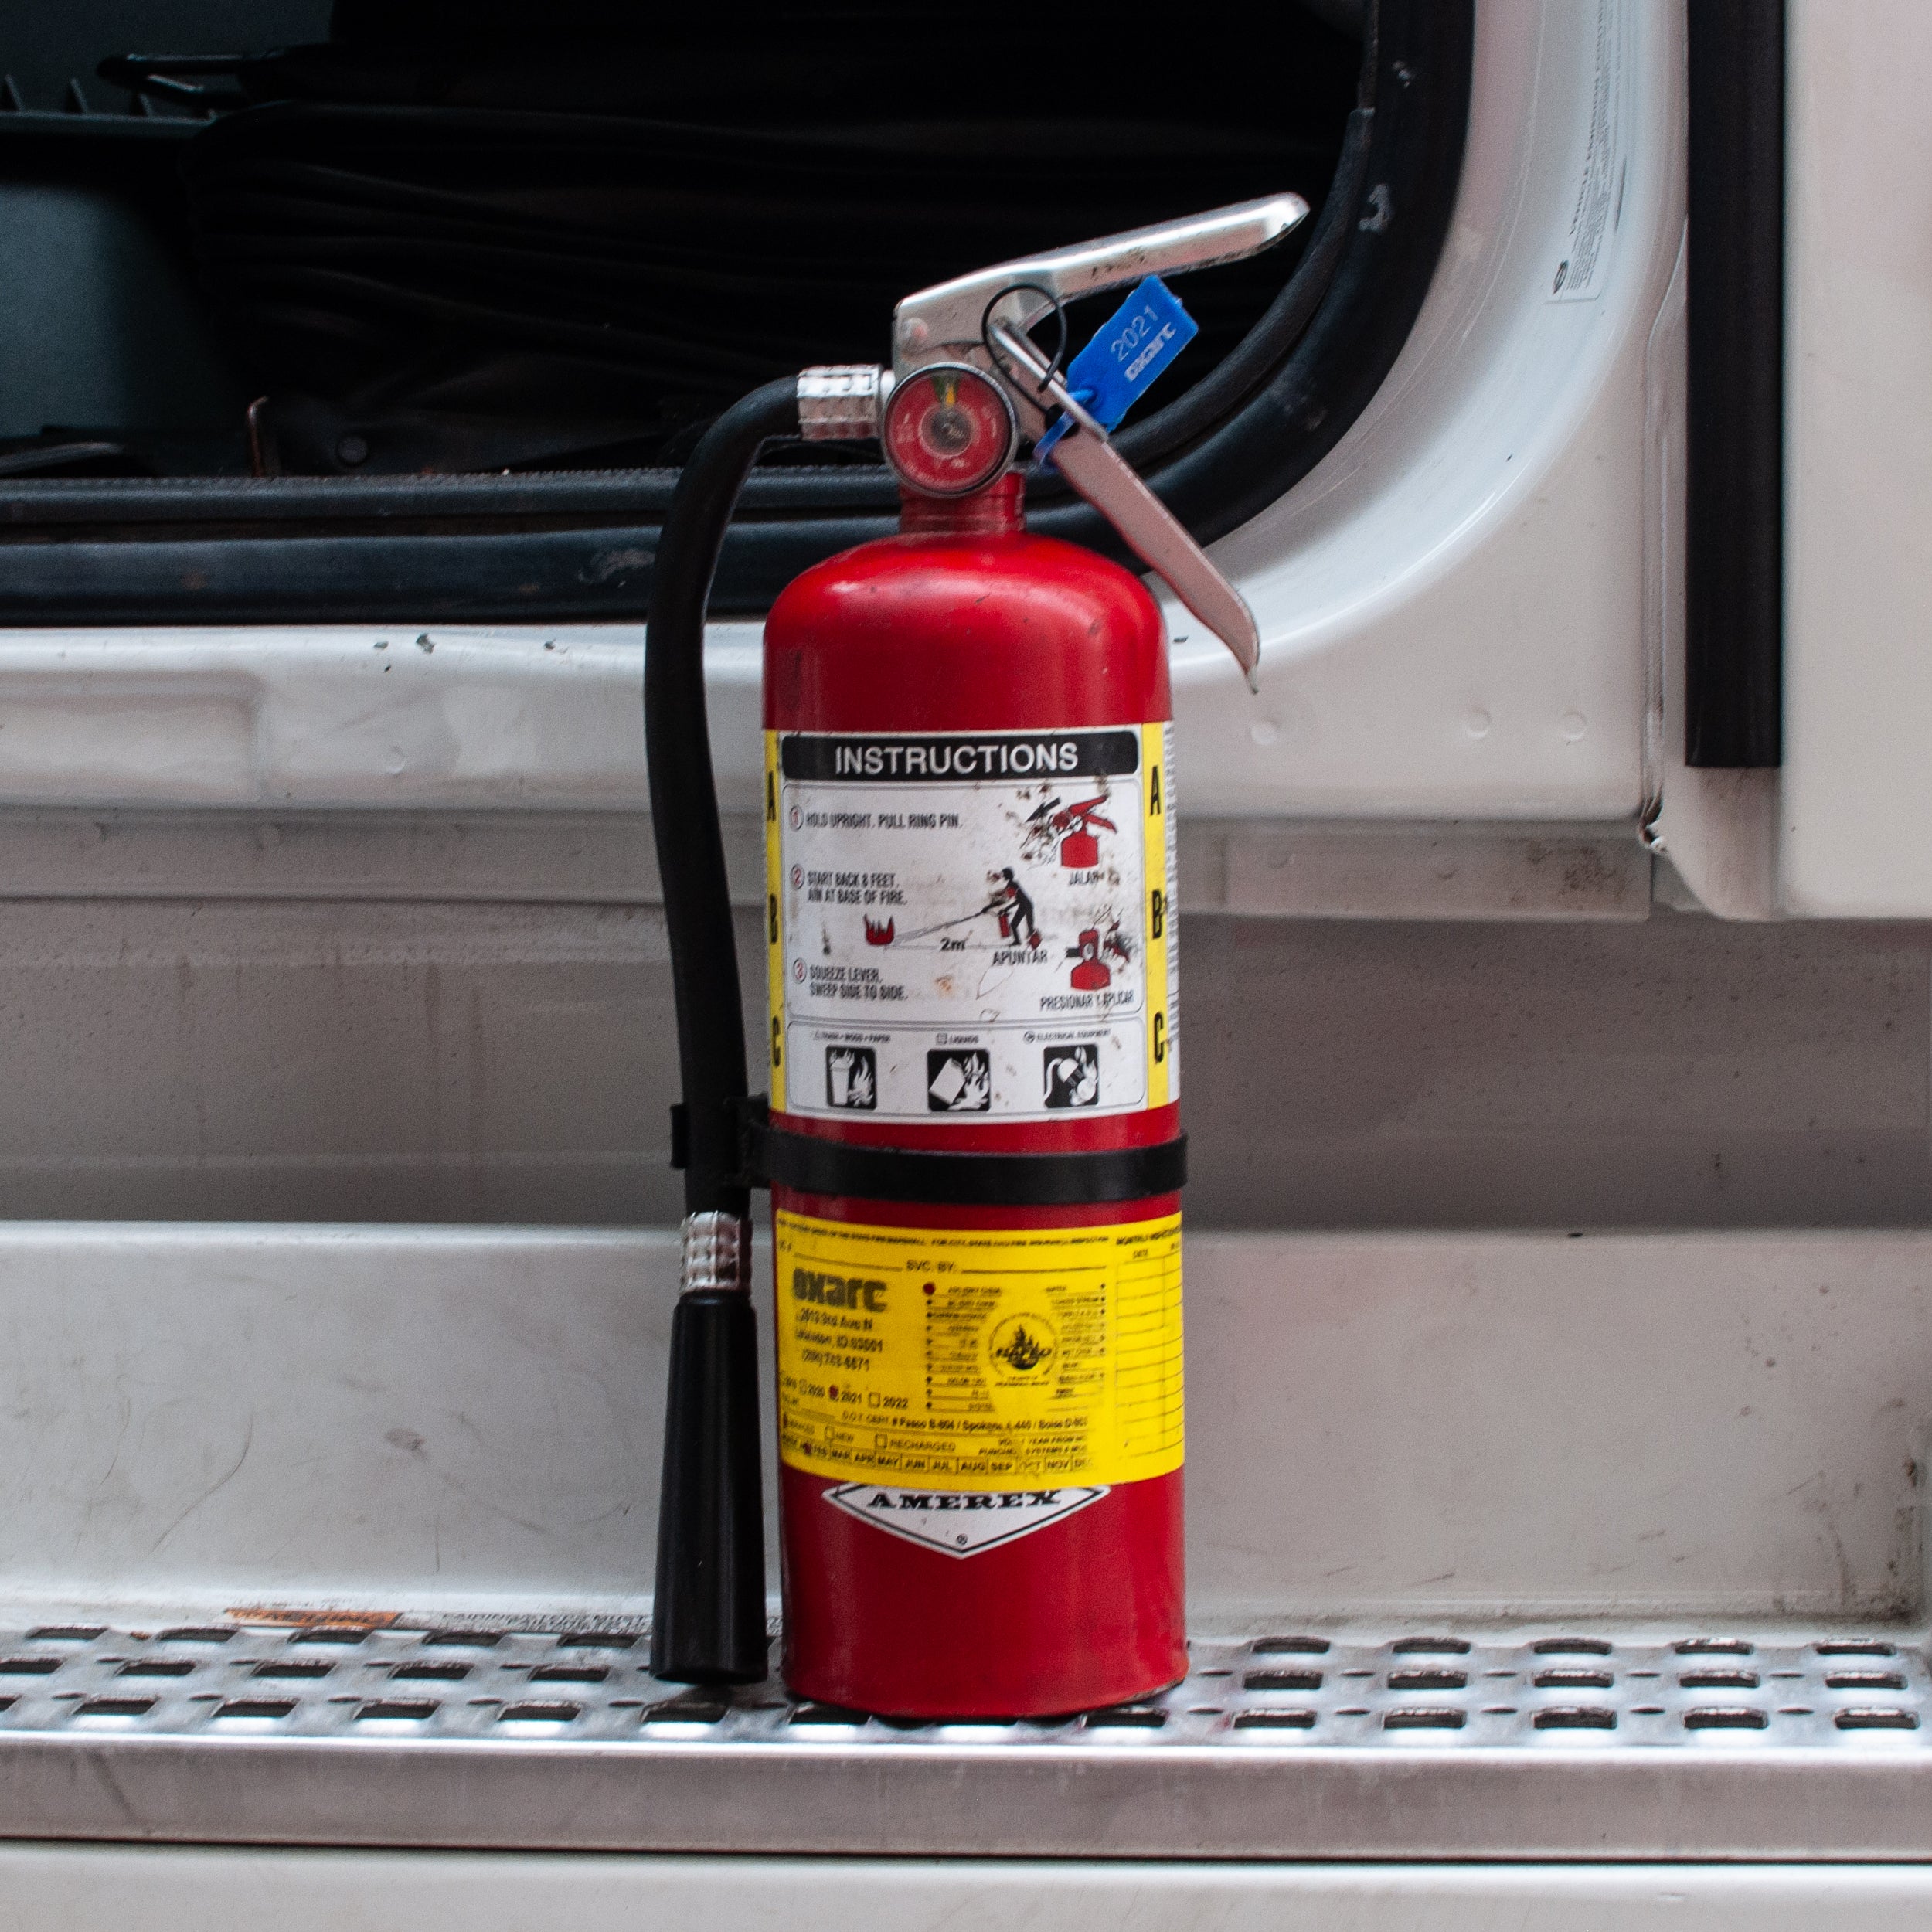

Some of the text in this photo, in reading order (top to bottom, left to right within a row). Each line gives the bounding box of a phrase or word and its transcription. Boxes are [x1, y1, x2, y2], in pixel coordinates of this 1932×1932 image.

[1111, 304, 1158, 362] 2021
[835, 742, 1079, 774] INSTRUCTIONS
[1150, 765, 1161, 816] A
[806, 812, 828, 828] HOLD
[878, 813, 906, 829] PULL
[908, 813, 936, 829] RING
[808, 871, 833, 886] START
[835, 872, 859, 887] BACK
[808, 889, 823, 902] AIM
[825, 889, 835, 903] AT
[837, 889, 861, 904] BASE
[864, 890, 878, 905] OF
[1152, 889, 1163, 939] B
[940, 937, 965, 951] 2m
[993, 949, 1047, 965] APUNTAR
[810, 965, 846, 981] SQUEEZE
[810, 982, 838, 998] SWEEP
[840, 984, 862, 999] SIDE
[864, 985, 878, 1000] TO
[1040, 996, 1092, 1011] PRESIONAR
[1154, 1012, 1165, 1063] C
[841, 1390, 862, 1404] 2021
[883, 1396, 909, 1410] 2022
[890, 1439, 957, 1453] RECHARGED
[831, 1447, 851, 1460] MAR
[877, 1454, 900, 1467] MAY
[904, 1458, 927, 1470] JUN
[932, 1459, 951, 1470] JUL
[961, 1461, 987, 1471] AUG
[990, 1461, 1014, 1472] SEP
[1046, 1459, 1070, 1469] NOV
[868, 1489, 1062, 1510] AMEREX
